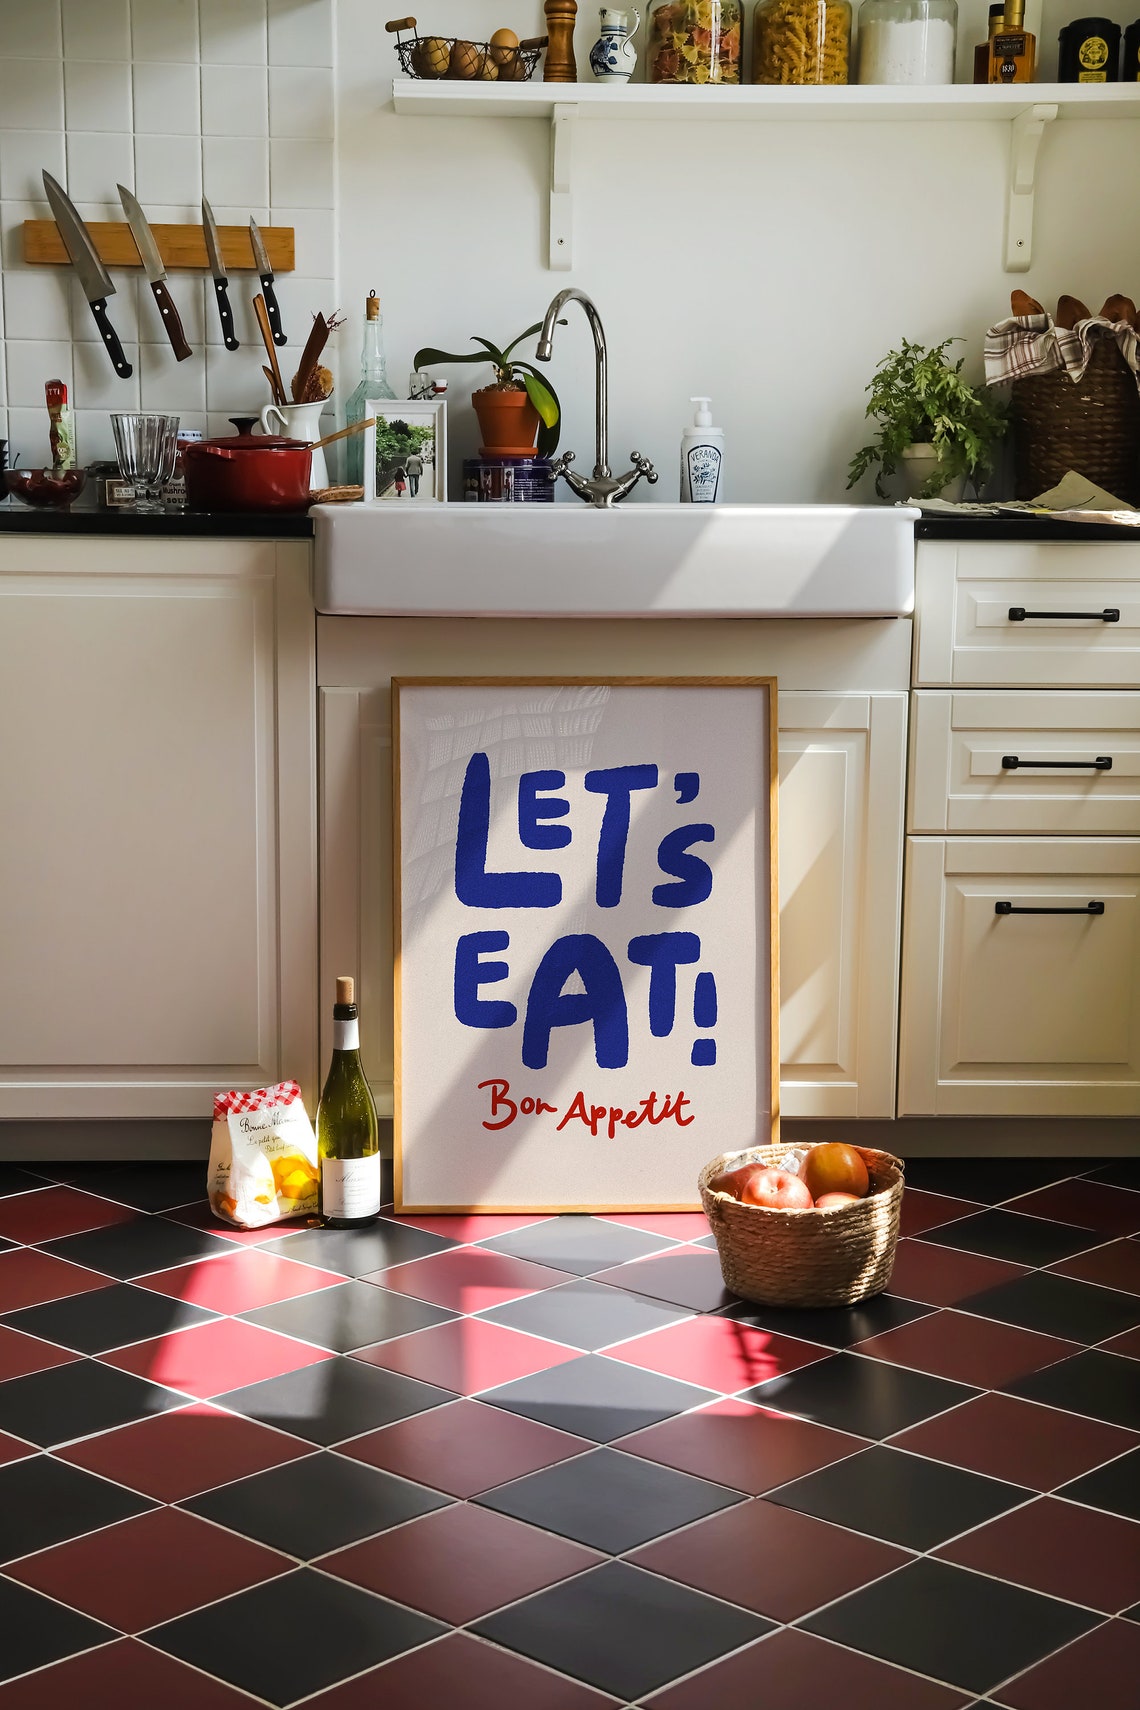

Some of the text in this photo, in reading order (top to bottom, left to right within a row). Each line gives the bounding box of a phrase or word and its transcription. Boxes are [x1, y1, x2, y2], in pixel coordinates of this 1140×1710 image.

[691, 449, 720, 463] VERANDA
[453, 929, 718, 1069] EAT!
[478, 1078, 696, 1139] Bon Appetit
